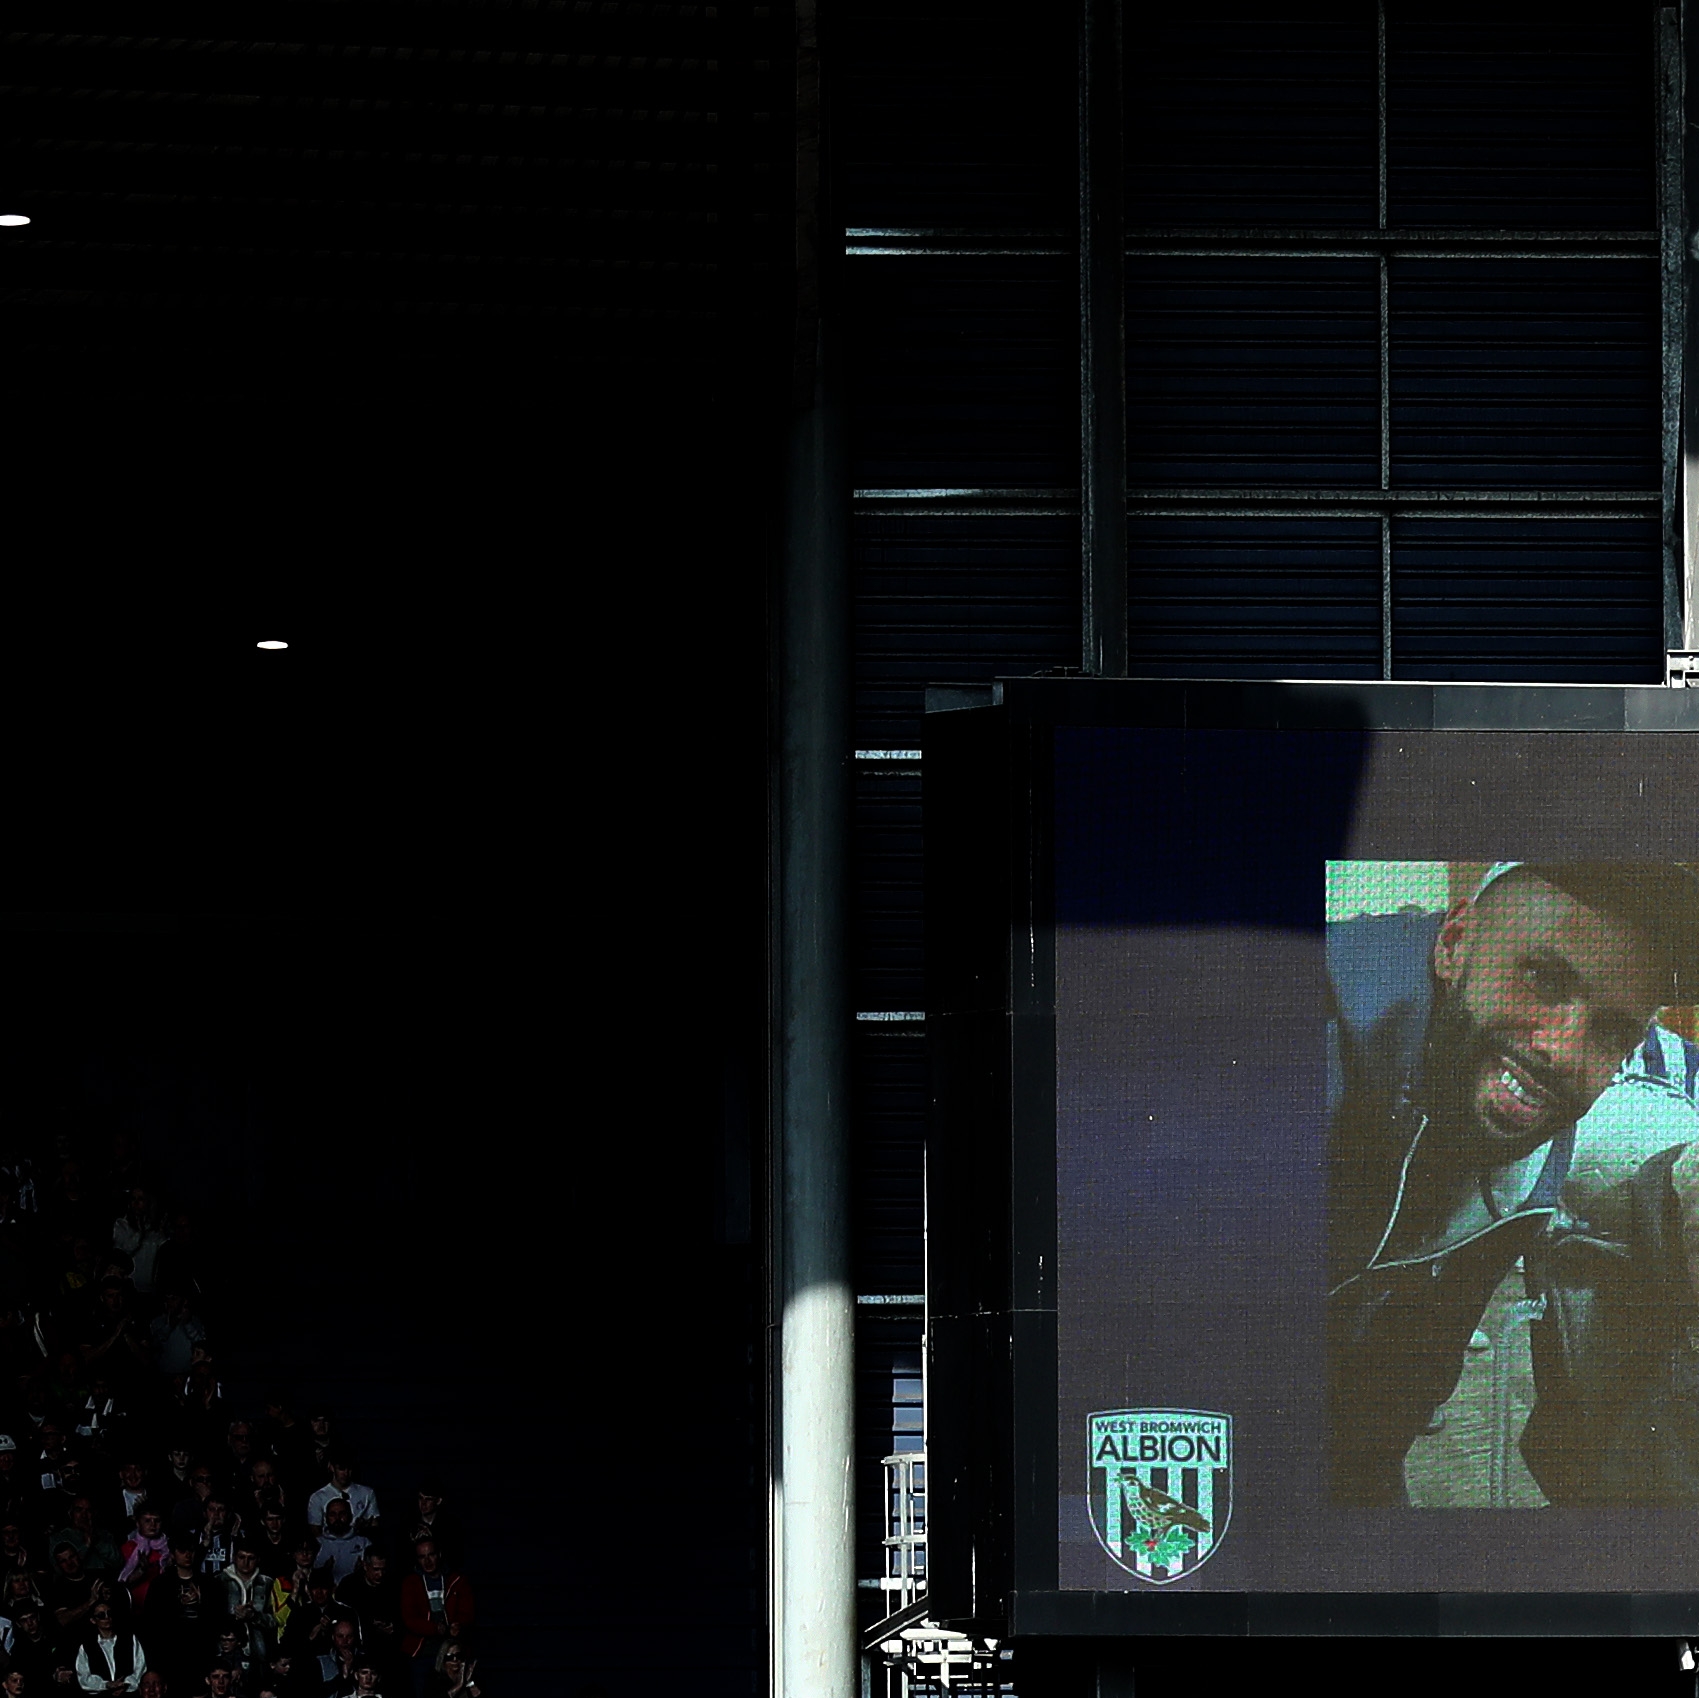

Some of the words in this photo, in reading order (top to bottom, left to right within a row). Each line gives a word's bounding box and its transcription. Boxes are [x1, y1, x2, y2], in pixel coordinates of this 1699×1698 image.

[1095, 1420, 1136, 1434] WEST
[1140, 1420, 1222, 1434] BROMWICH
[1095, 1434, 1221, 1462] ALBION
